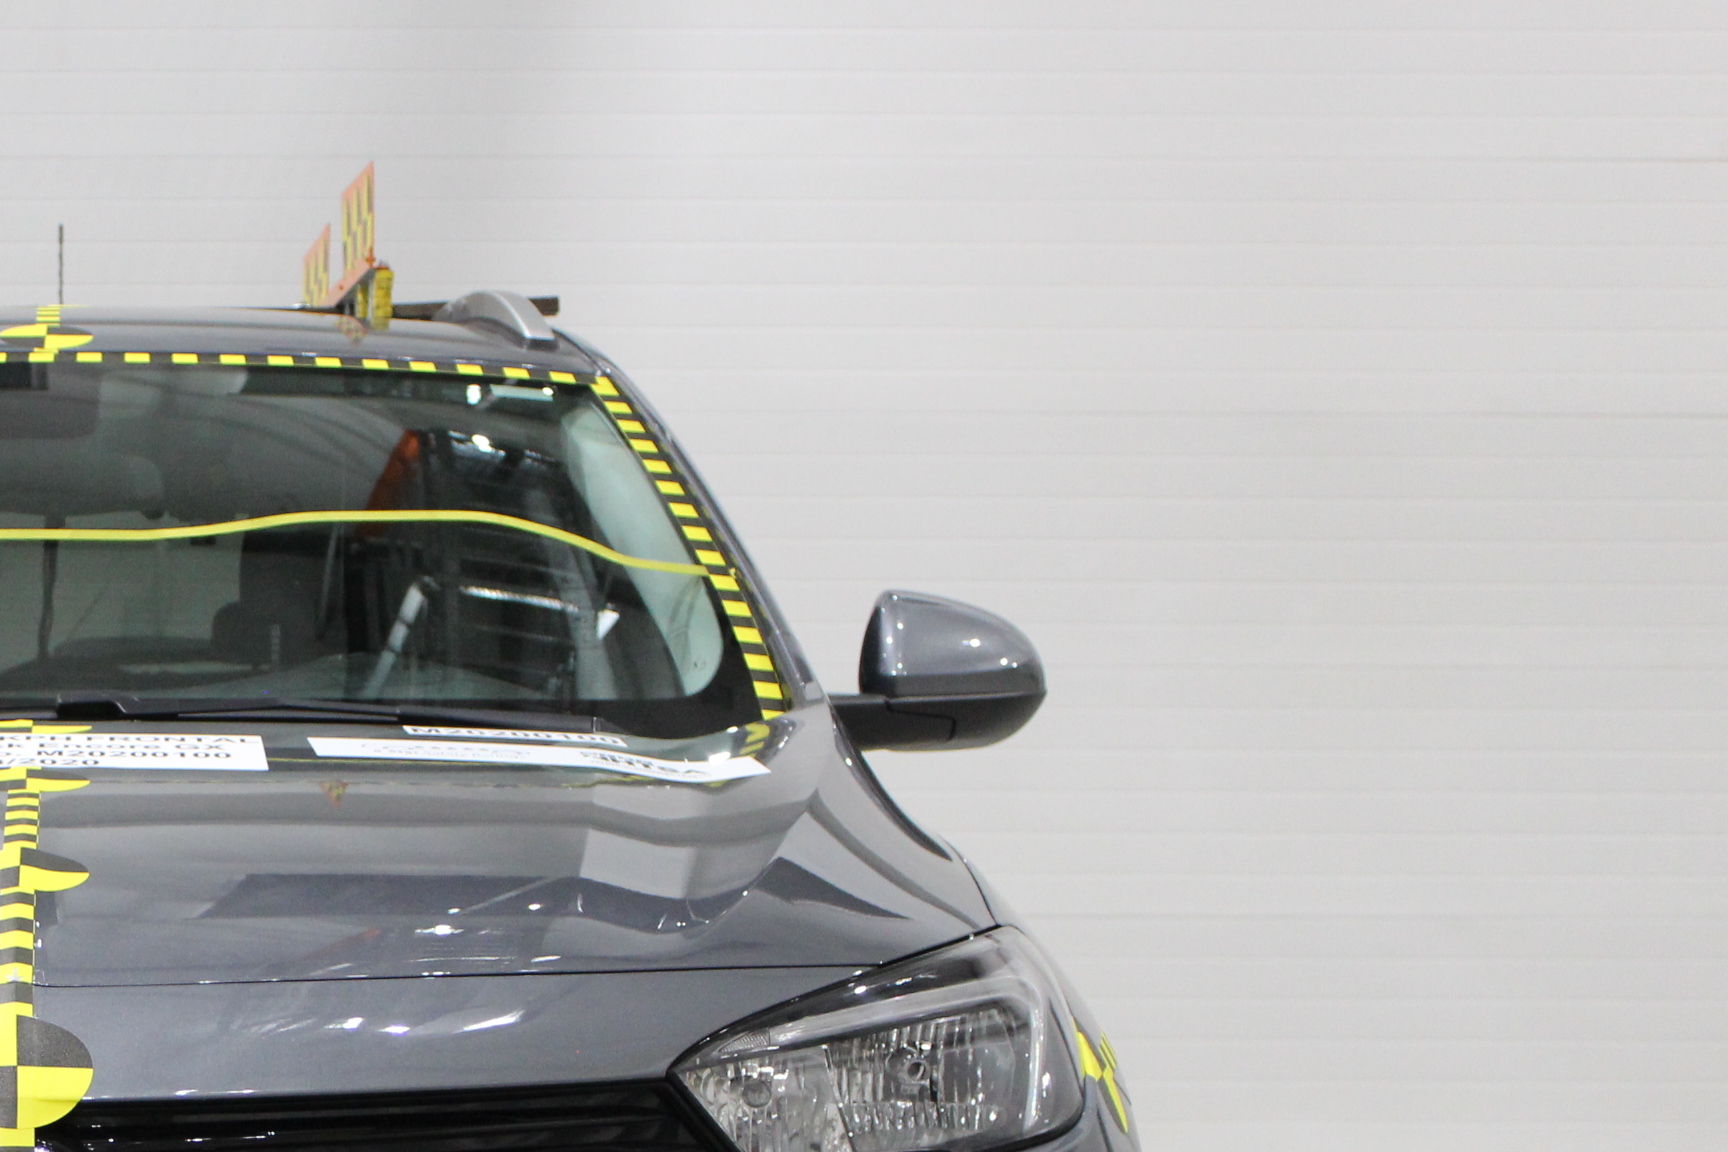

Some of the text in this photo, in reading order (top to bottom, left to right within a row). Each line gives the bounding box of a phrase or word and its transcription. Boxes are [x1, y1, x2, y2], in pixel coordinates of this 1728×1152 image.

[87, 736, 260, 744] FRONTAL
[38, 742, 161, 750] Encore
[37, 750, 233, 759] M20200100
